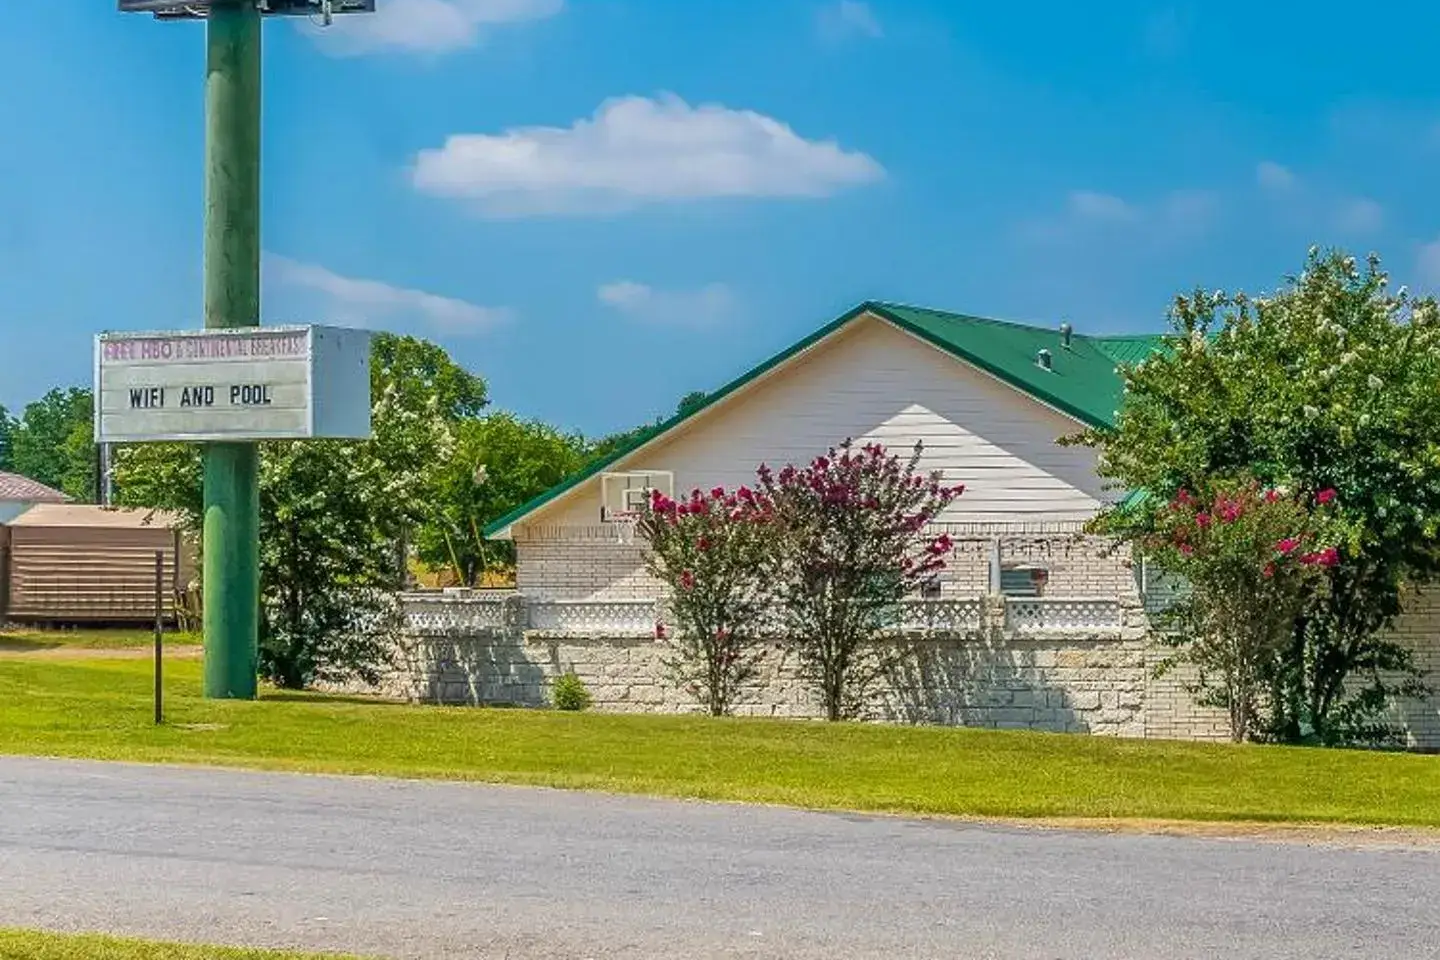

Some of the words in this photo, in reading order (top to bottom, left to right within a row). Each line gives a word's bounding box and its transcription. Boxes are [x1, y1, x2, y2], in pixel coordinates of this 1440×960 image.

[129, 388, 164, 408] WIFI
[180, 387, 214, 406] AND
[230, 385, 272, 405] POOL
